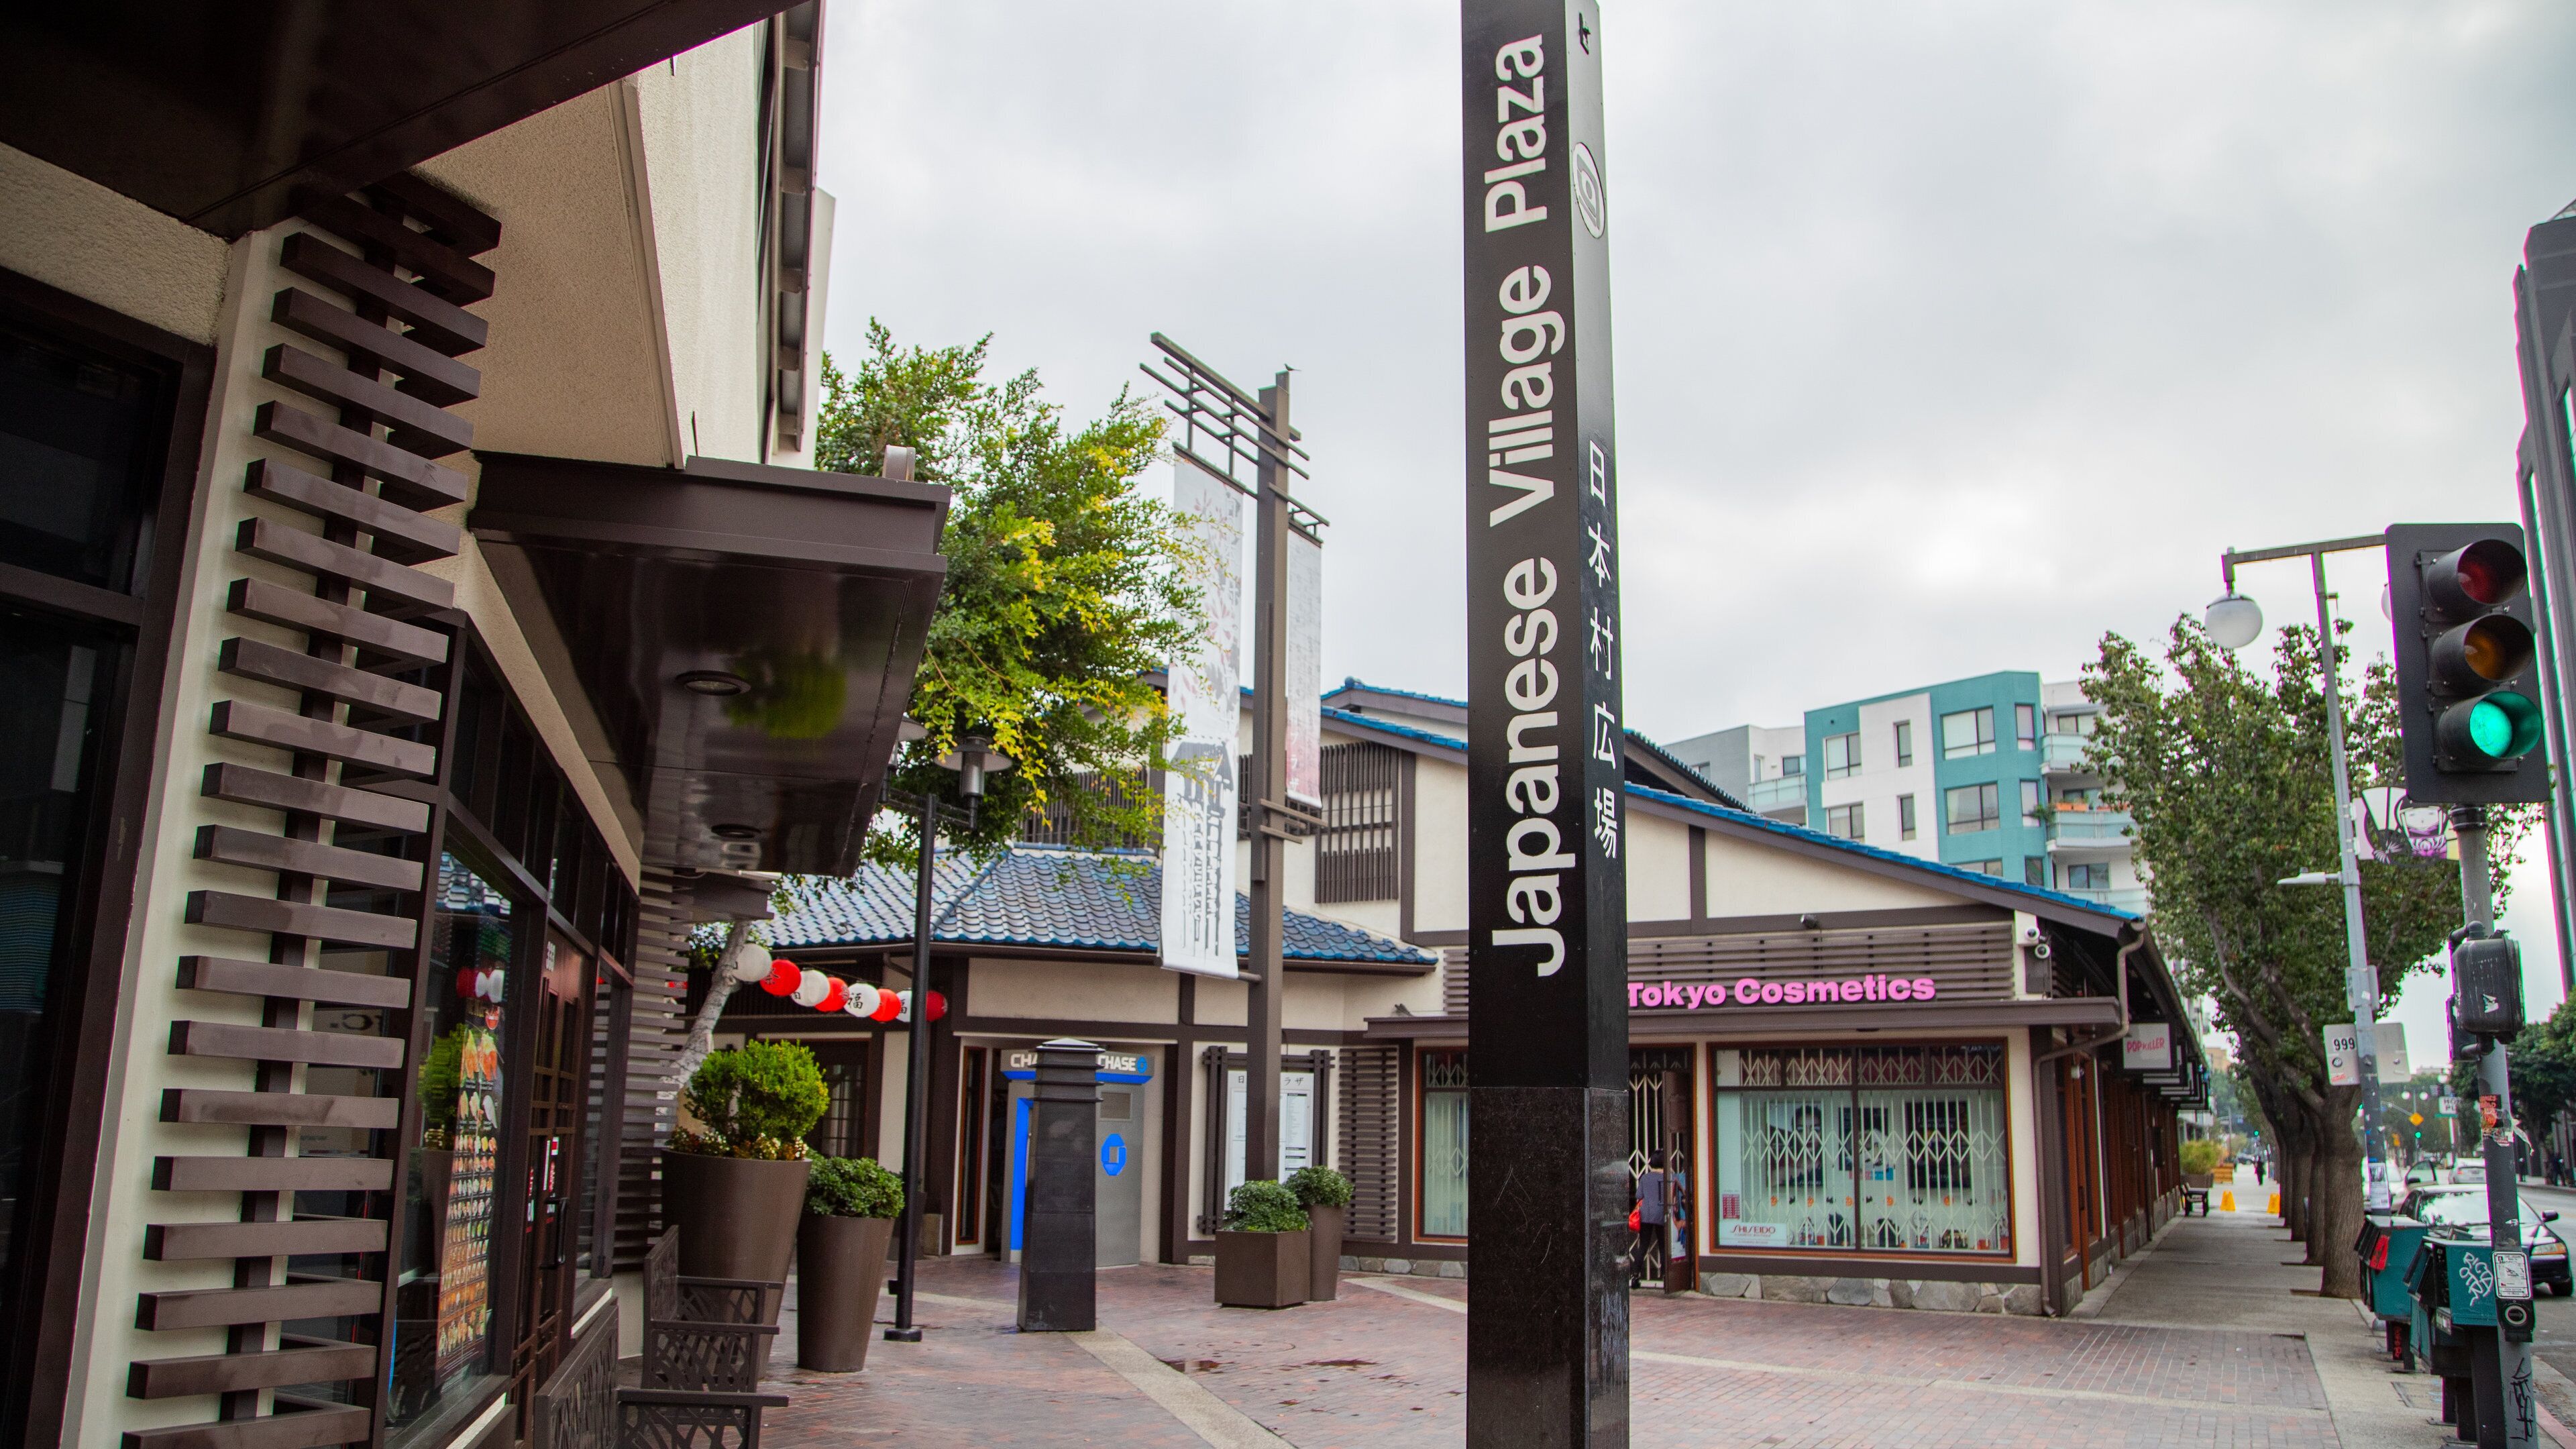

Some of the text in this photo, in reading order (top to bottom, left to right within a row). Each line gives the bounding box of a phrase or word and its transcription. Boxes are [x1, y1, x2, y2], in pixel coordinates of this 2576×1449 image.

[1484, 34, 1576, 977] Japanese Village Plaza
[1587, 439, 1618, 859] 日本村広場
[1627, 974, 1936, 1010] Tokyo Cosmetics
[847, 992, 863, 1009] 福
[2333, 1037, 2355, 1051] 999
[1010, 1053, 1038, 1067] CHA
[1097, 1055, 1136, 1071] CHASE
[1731, 1224, 1776, 1234] SHISEIDO
